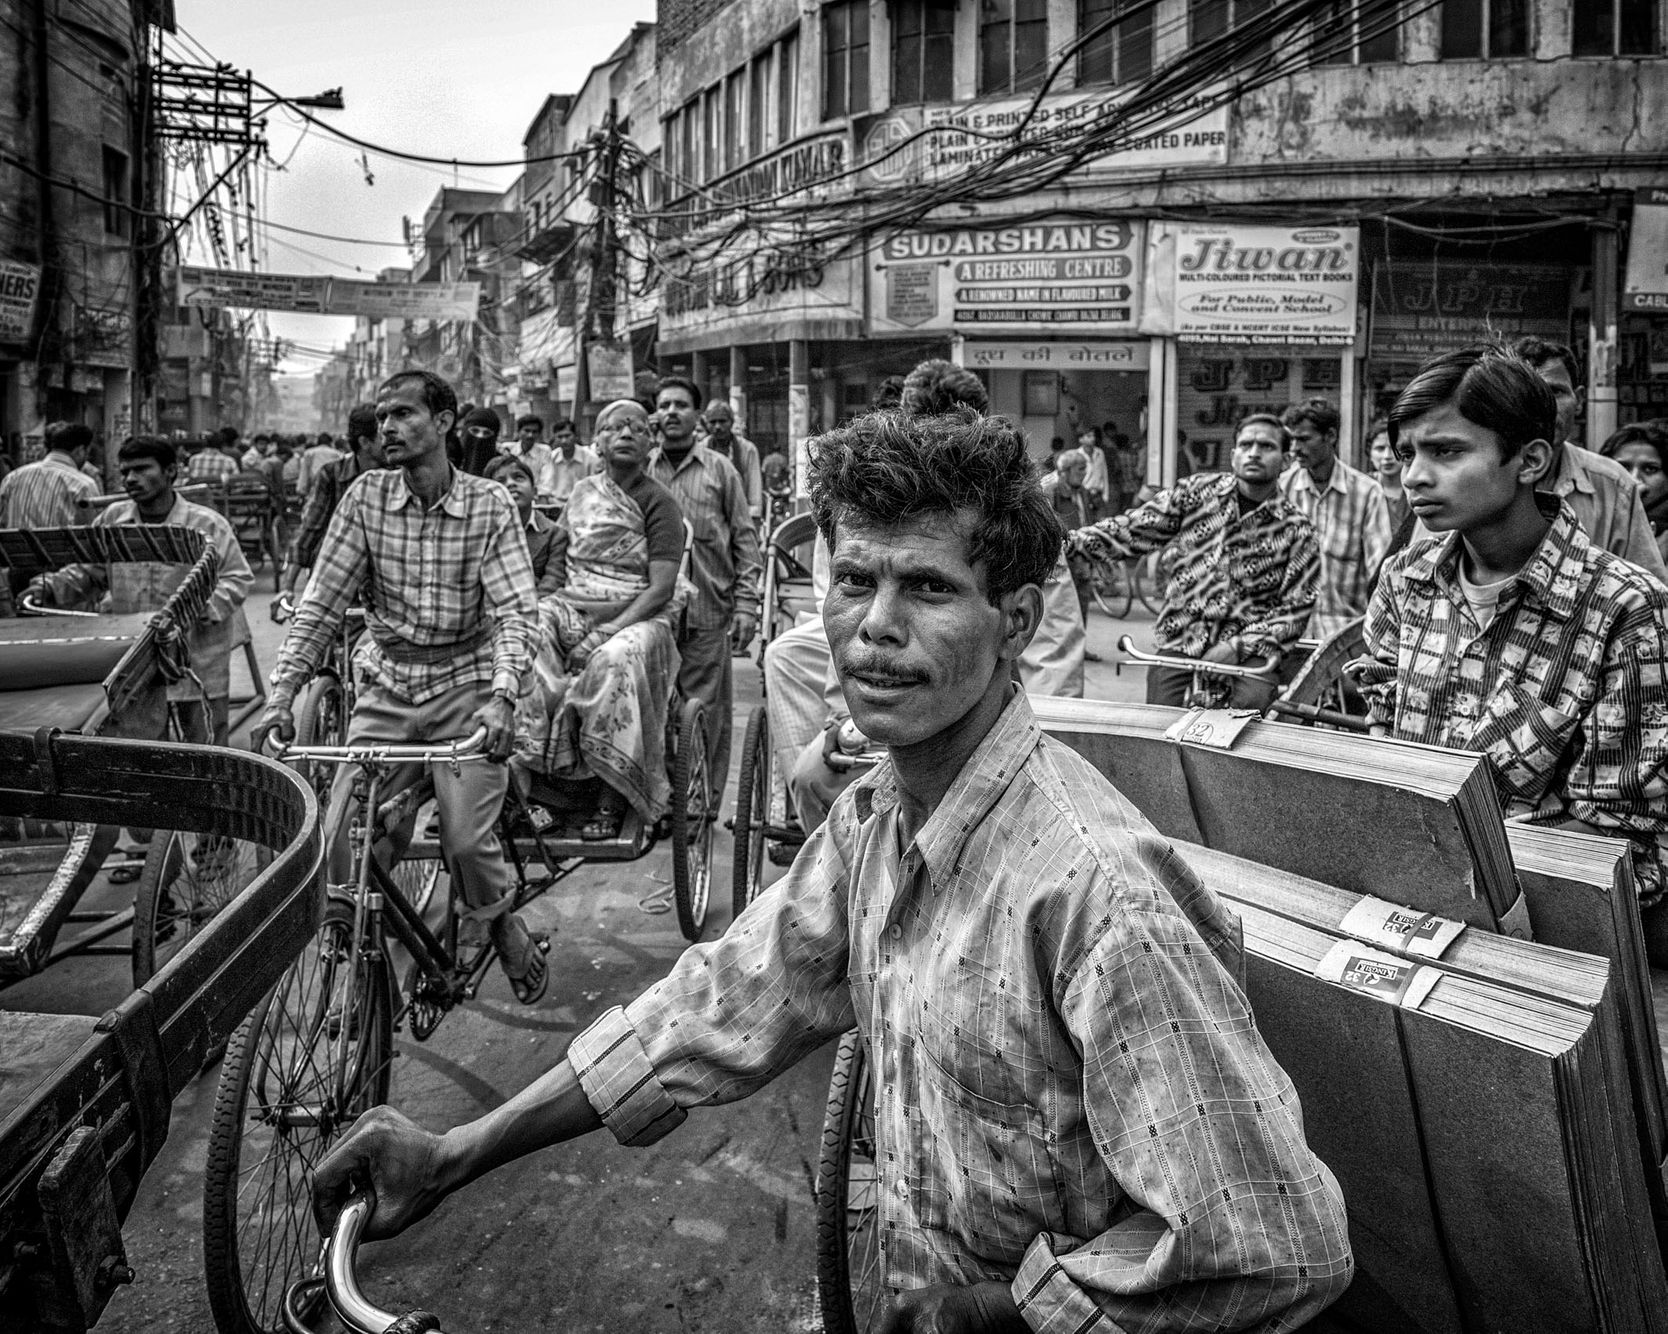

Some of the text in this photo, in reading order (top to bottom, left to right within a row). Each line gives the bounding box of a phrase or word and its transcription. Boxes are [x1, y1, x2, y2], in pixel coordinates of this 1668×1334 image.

[1183, 130, 1226, 147] PAPER
[891, 224, 1121, 258] SUDARSHAN'S
[1179, 237, 1350, 272] Jiwan
[960, 256, 1123, 280] A REFRESHING CENTRE
[1178, 272, 1353, 283] MULTI-COLOURED PICTORIAL TEXT BOOKS
[1199, 294, 1325, 306] For Public, Model
[1191, 304, 1333, 313] and Convent School
[973, 345, 1005, 366] दूध
[1022, 344, 1052, 363] की
[1186, 723, 1210, 737] 32
[1384, 922, 1400, 933] 32
[1345, 970, 1361, 983] 32
